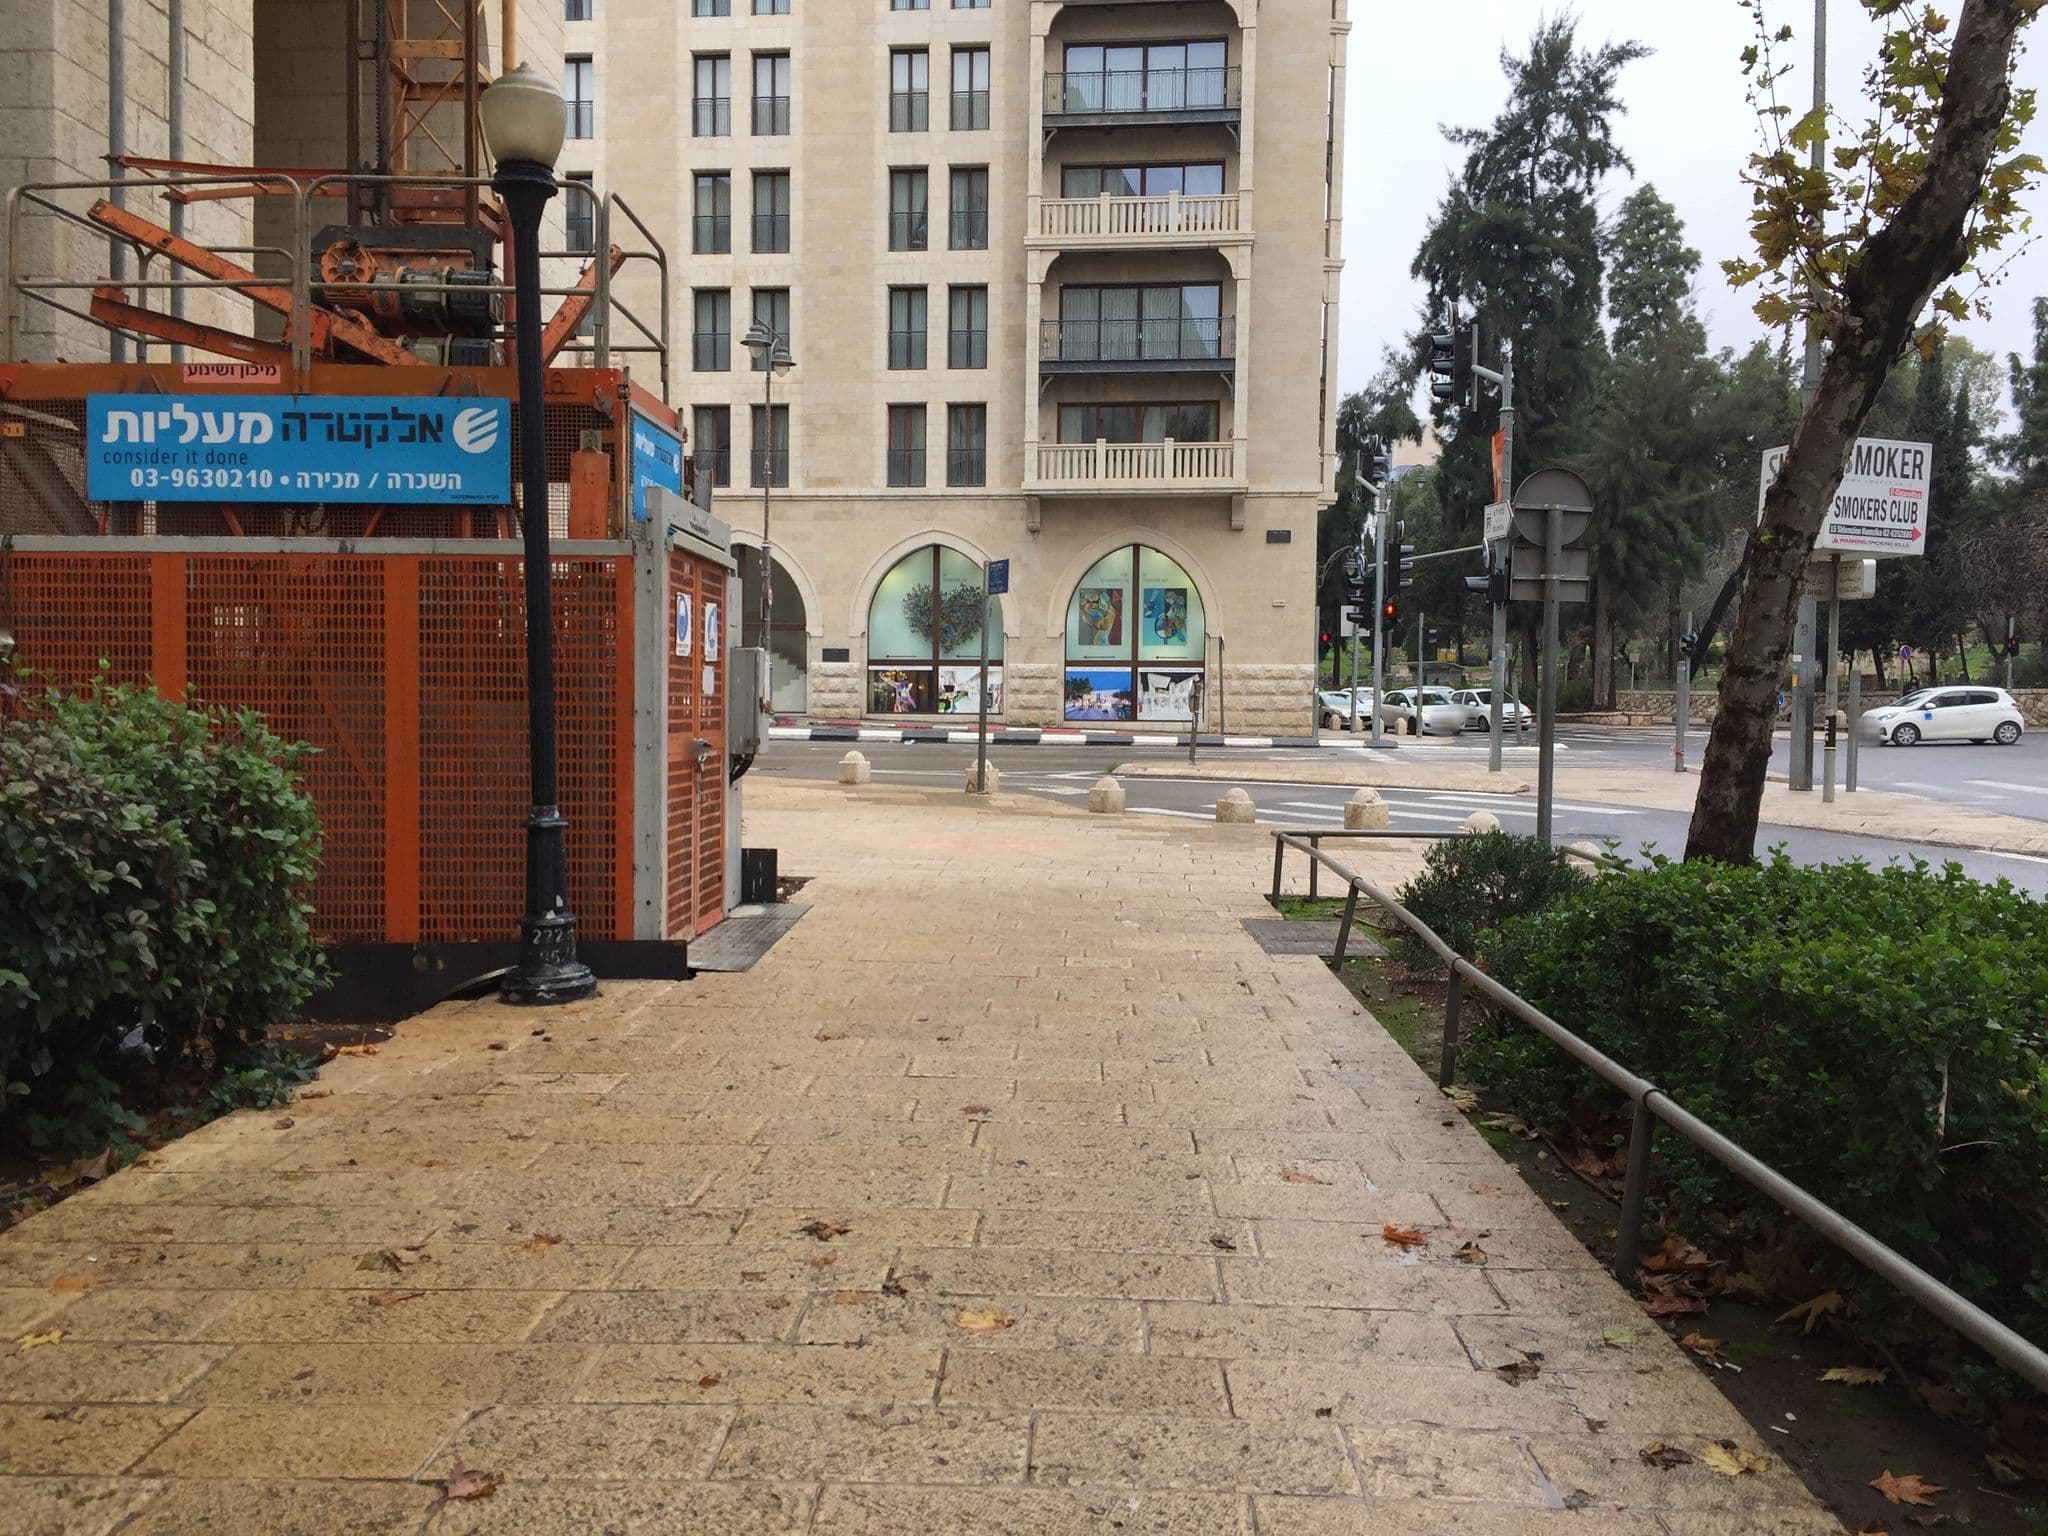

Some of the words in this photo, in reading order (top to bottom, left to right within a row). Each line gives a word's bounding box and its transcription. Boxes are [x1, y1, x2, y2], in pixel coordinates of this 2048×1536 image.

[187, 364, 235, 377] ושינוע
[240, 364, 277, 379] מיכון
[102, 403, 273, 444] מעליות
[282, 406, 443, 449] אלקטרה
[103, 449, 177, 465] consider
[185, 449, 198, 465] it
[205, 450, 248, 465] done
[1847, 444, 1924, 480] MOKER
[130, 468, 273, 488] 03-9630210
[296, 471, 360, 489] מכירה
[387, 472, 462, 490] השכרה
[1834, 495, 1887, 522] SMOKERS
[1890, 499, 1919, 524] CLUB
